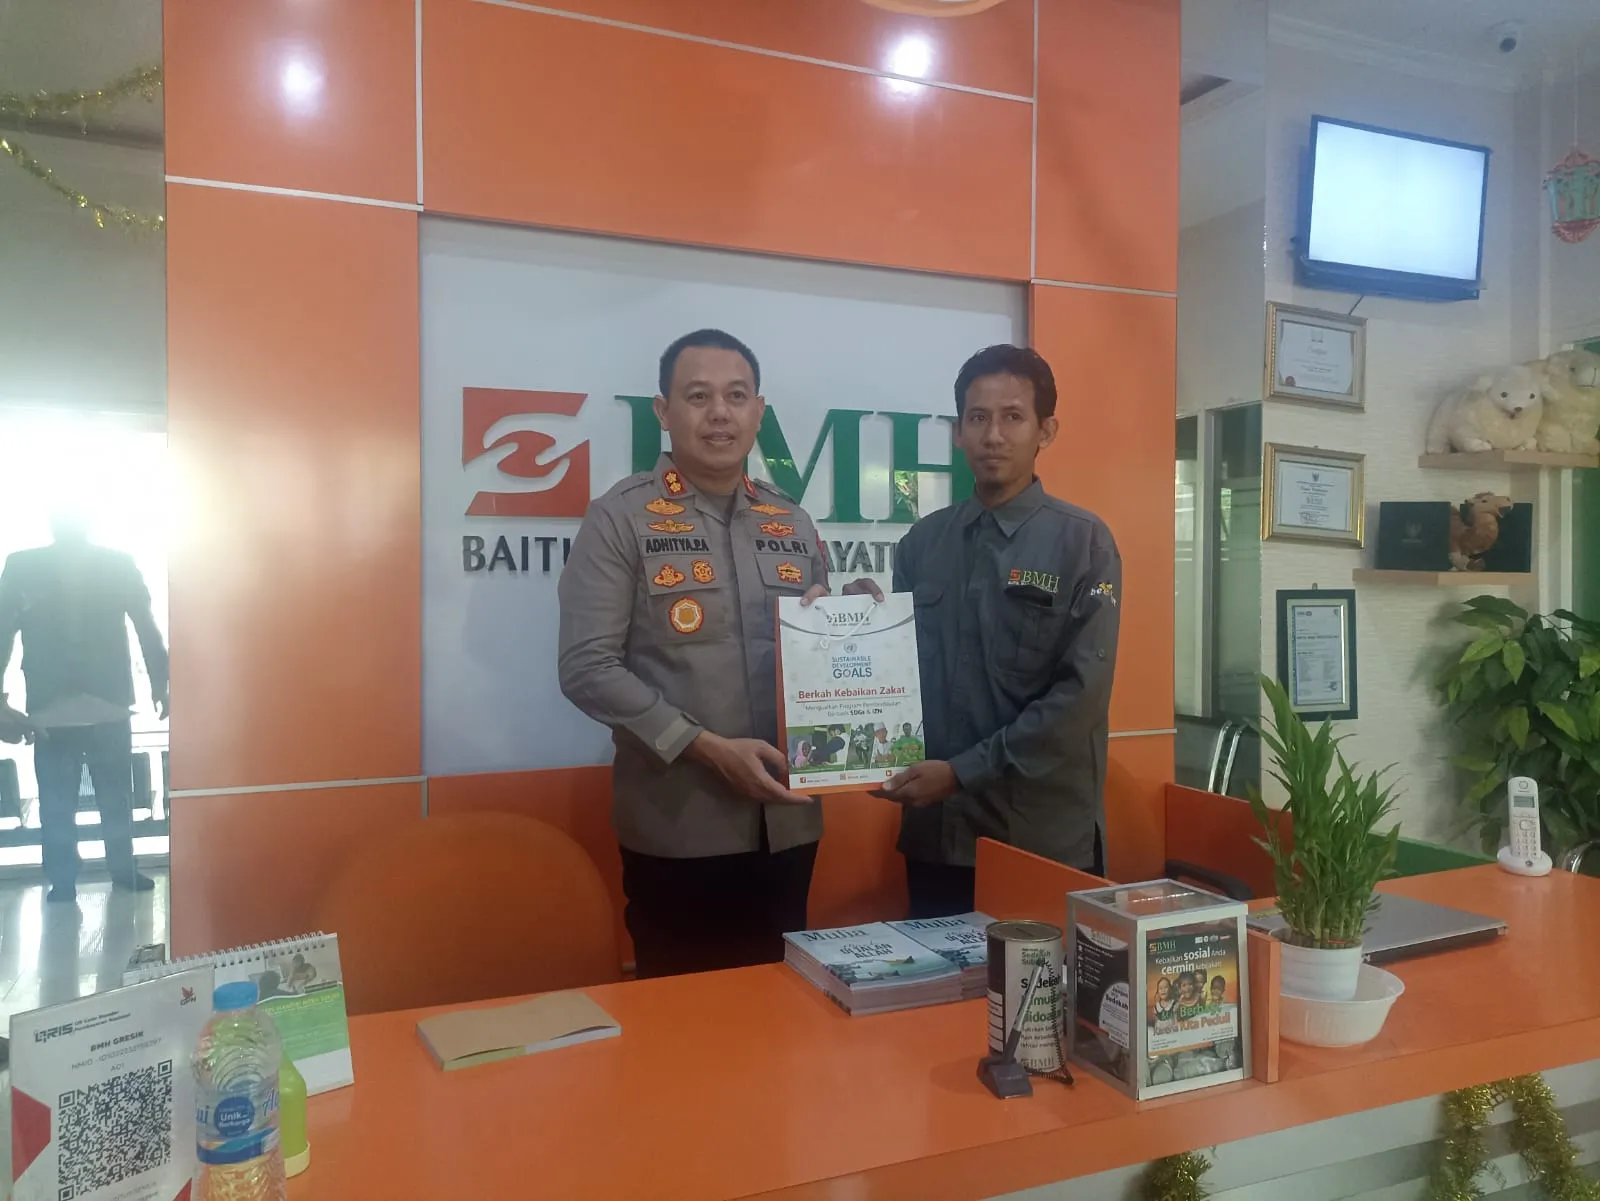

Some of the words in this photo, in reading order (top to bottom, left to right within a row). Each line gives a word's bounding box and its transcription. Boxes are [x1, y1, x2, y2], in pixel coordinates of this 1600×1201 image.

[755, 539, 808, 555] POLRI
[1022, 570, 1060, 592] BMH
[832, 667, 873, 679] GOALS
[798, 689, 832, 700] Berkah
[834, 687, 877, 698] Kebaikan
[879, 685, 906, 696] Zakat
[903, 917, 969, 931] Mulia
[800, 926, 869, 942] Mulia
[1157, 940, 1176, 951] BMH
[854, 948, 894, 959] ALLAH
[1183, 946, 1211, 961] sosial
[1161, 960, 1195, 976] cermin
[112, 1030, 144, 1046] GRESIK
[220, 1110, 243, 1122] Unik
